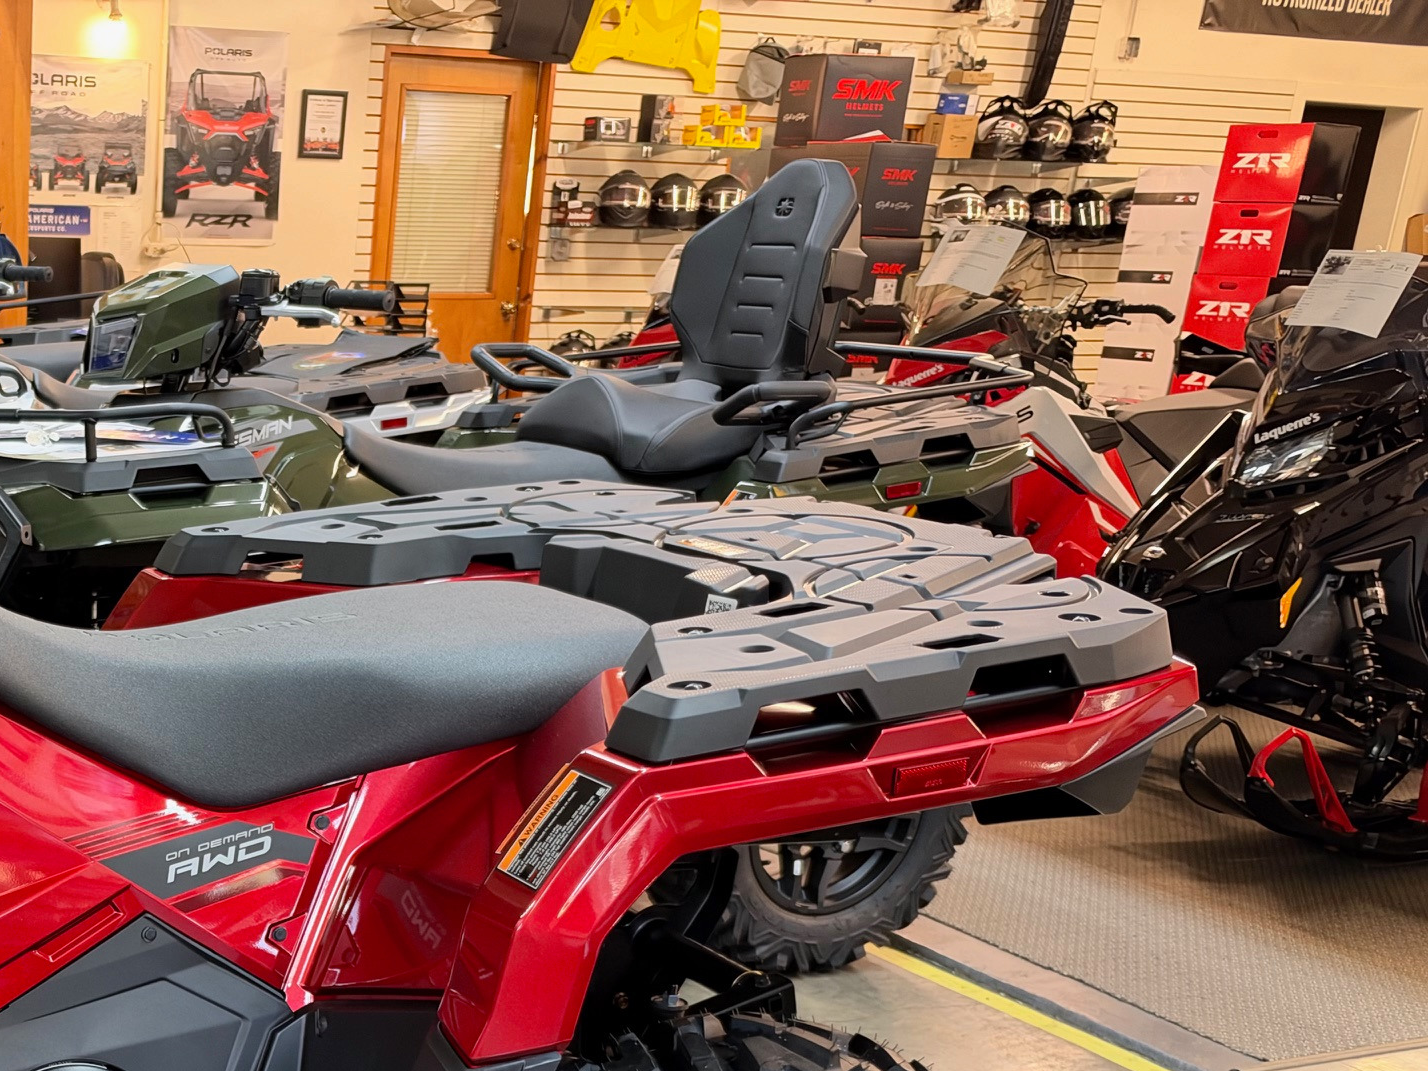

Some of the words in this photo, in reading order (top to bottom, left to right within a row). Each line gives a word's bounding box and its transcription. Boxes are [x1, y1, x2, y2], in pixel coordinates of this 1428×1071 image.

[1346, 0, 1392, 16] DEALER
[204, 47, 253, 57] POLARIS
[32, 73, 96, 87] OLARIS
[832, 78, 902, 101] SMK
[846, 102, 884, 111] HELMETS
[1232, 153, 1291, 169] Z1R
[881, 168, 918, 182] SMK
[28, 214, 80, 226] AMERICAN
[185, 213, 253, 229] RZR
[1215, 229, 1272, 245] Z1R
[871, 262, 906, 274] SMK
[1196, 300, 1250, 317] Z1R
[1254, 412, 1321, 445] Laquerre's
[523, 793, 559, 837] WARNING
[165, 847, 190, 862] ON
[197, 822, 275, 852] DEMAND
[166, 835, 272, 884] AWD
